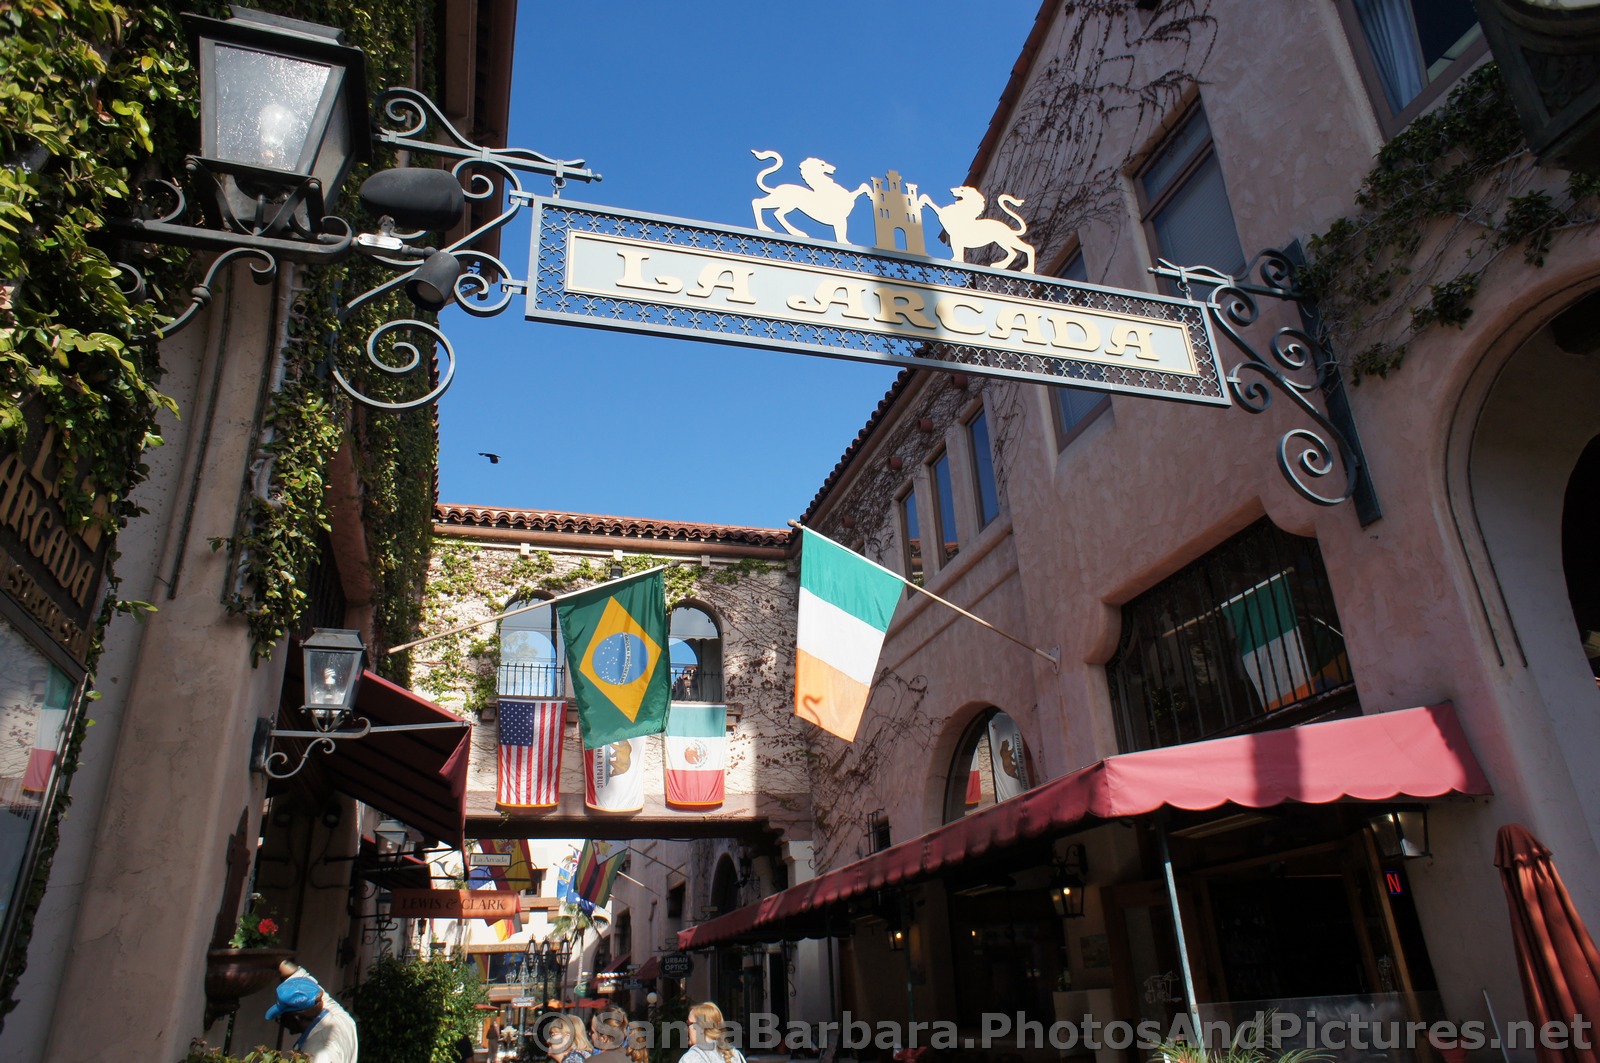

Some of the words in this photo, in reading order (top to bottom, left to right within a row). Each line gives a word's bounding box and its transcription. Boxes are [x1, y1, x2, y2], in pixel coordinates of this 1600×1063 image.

[615, 249, 757, 305] LA
[786, 279, 1161, 363] ARCADA
[0, 450, 95, 609] ARCADA
[596, 761, 604, 788] REPUBLIC
[401, 897, 442, 910] LEWIS
[446, 898, 459, 910] &
[461, 898, 506, 910] CLARK
